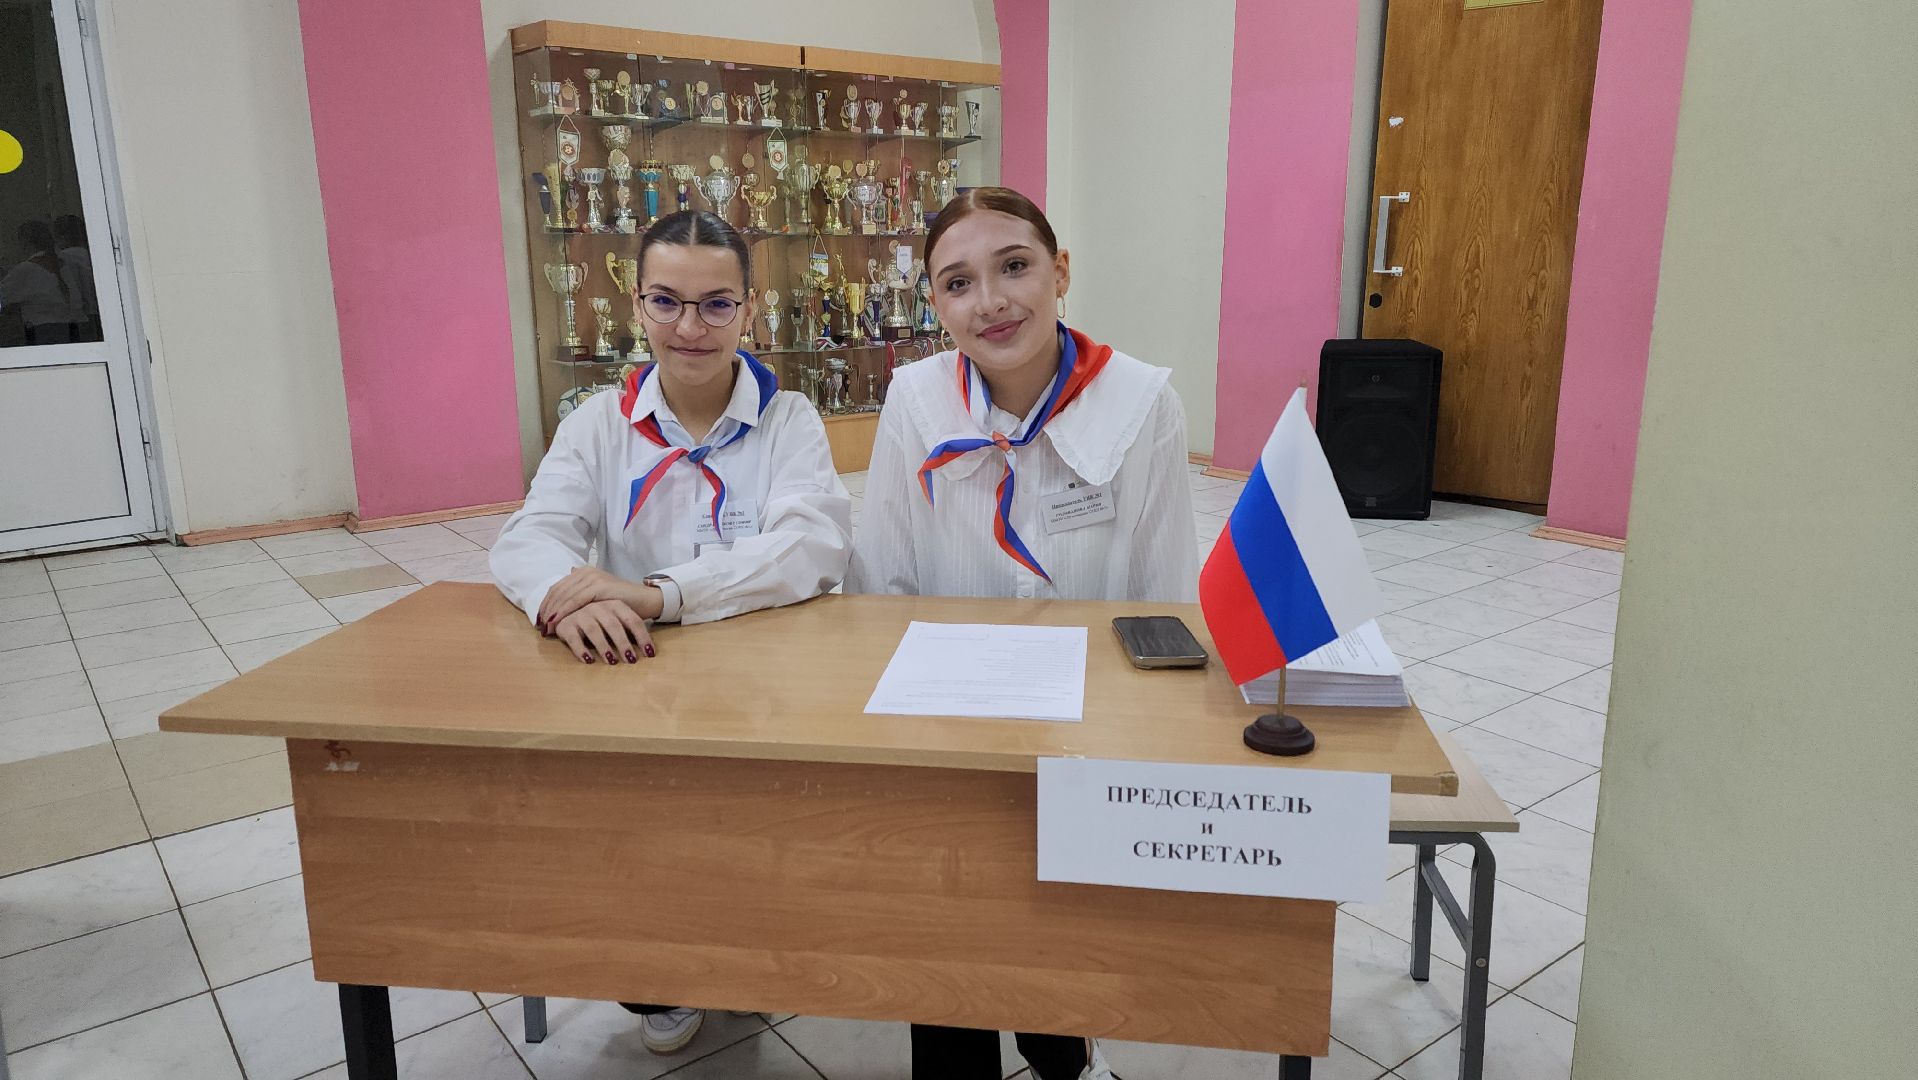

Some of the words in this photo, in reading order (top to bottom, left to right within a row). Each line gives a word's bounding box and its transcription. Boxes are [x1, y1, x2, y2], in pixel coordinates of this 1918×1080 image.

[1107, 786, 1312, 814] ПРЕДСЕДАТЕЛЬ
[1202, 823, 1213, 834] и
[1133, 841, 1282, 866] СЕКРЕТАРЬ
